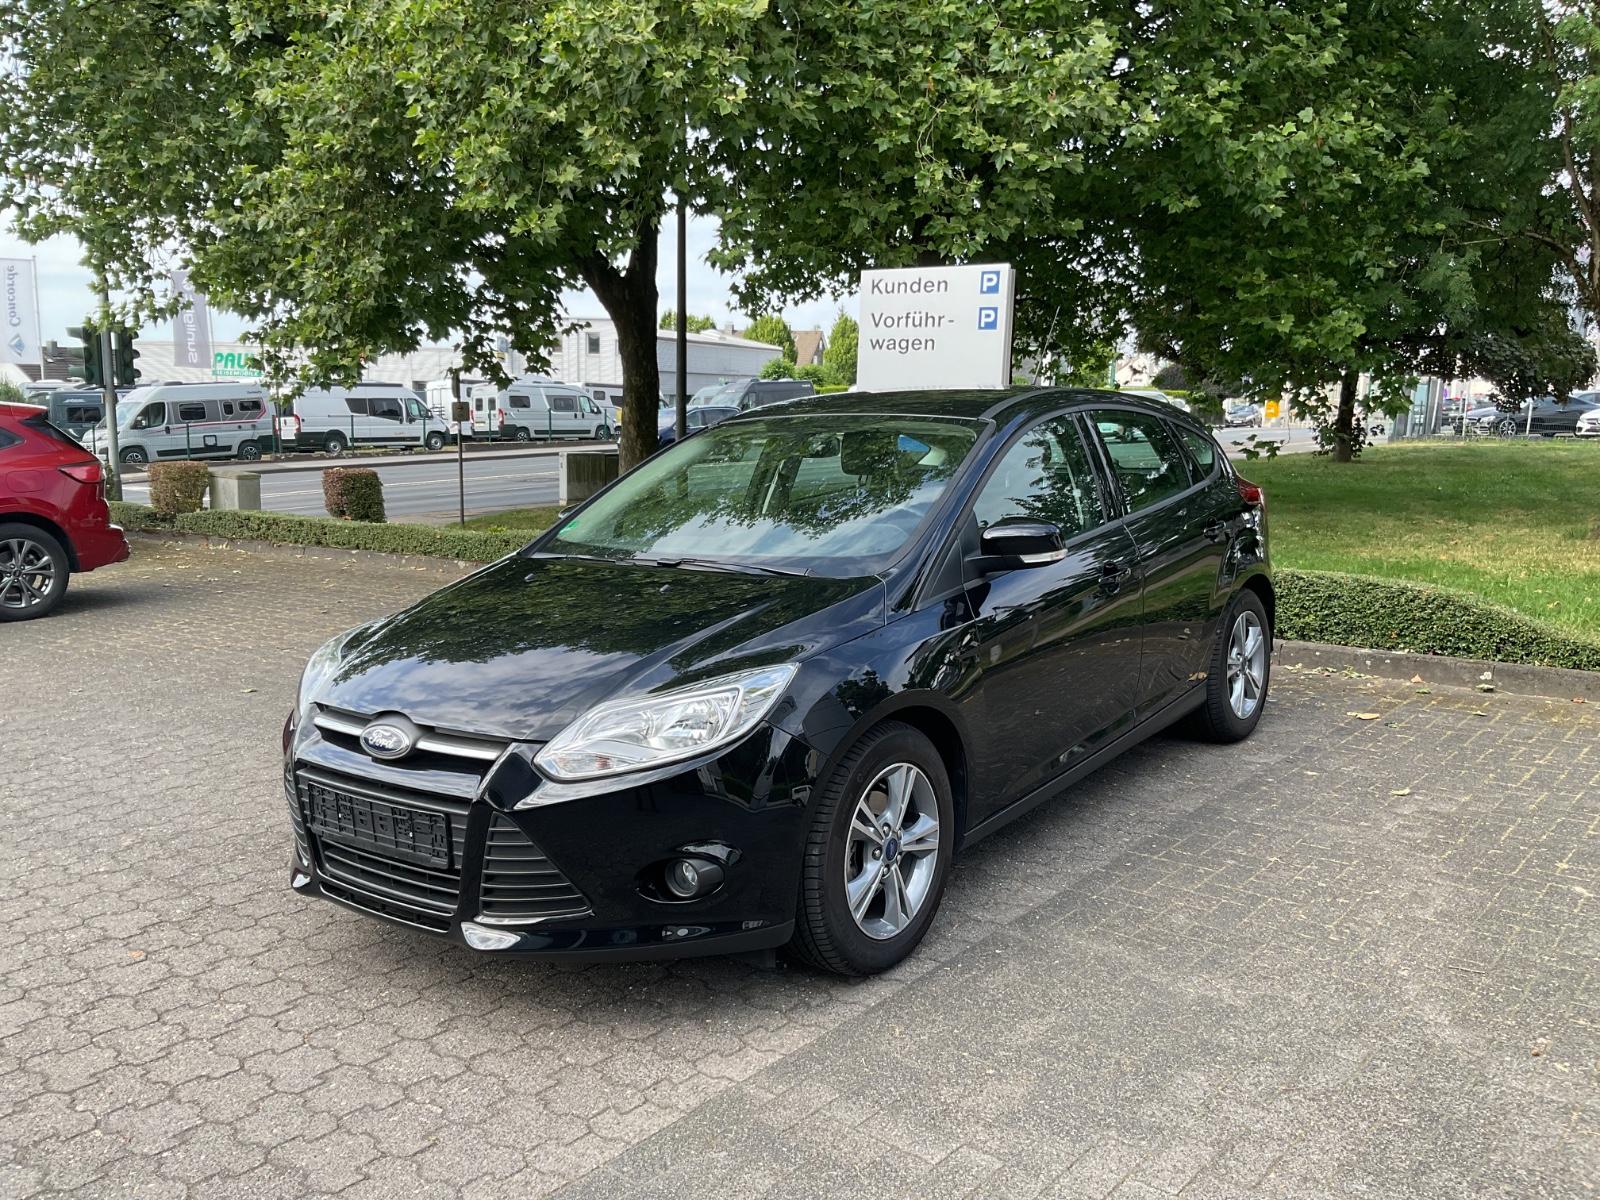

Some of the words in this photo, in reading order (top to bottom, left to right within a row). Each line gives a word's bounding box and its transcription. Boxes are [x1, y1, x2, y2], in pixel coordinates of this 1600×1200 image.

[871, 277, 949, 295] Kunden
[982, 273, 998, 292] P
[871, 311, 955, 329] Vorführ-
[980, 309, 996, 328] P
[870, 338, 936, 355] wagen
[214, 352, 255, 369] PAU
[368, 729, 397, 749] Ford
